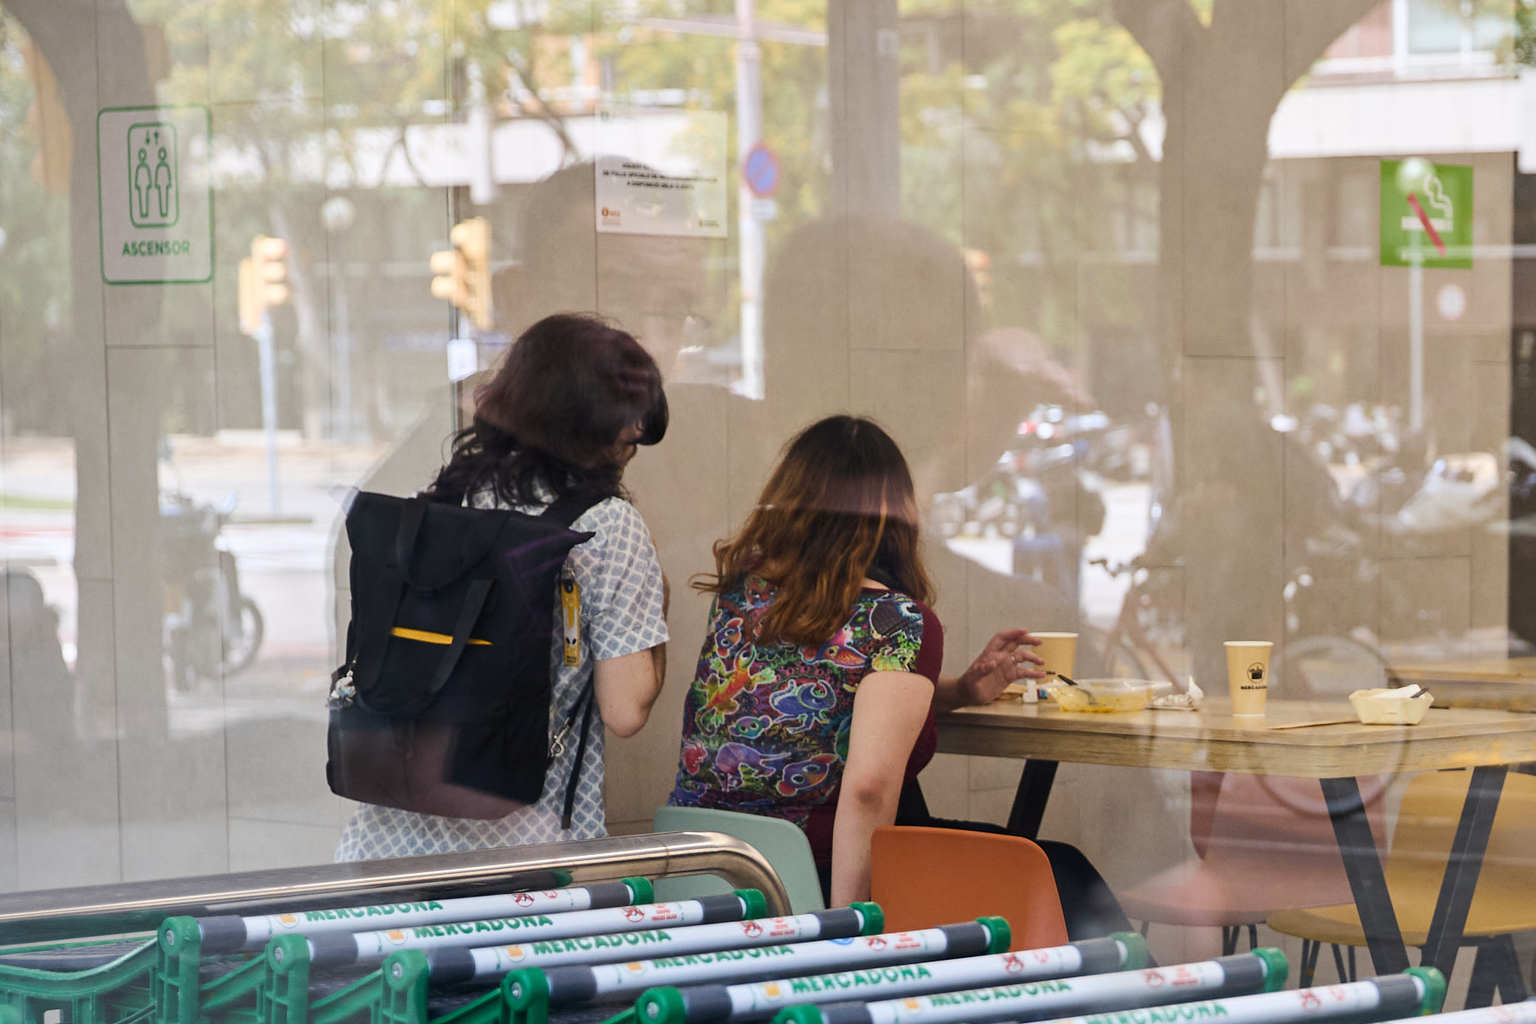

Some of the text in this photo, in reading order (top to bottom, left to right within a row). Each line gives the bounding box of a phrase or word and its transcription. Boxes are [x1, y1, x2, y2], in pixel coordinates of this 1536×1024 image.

[122, 240, 190, 256] ASCENSOR
[304, 900, 443, 922] MERCADONA
[413, 914, 553, 938] MERCADONA
[531, 929, 672, 956] MERCADONA
[652, 944, 795, 969] MERCADONA
[788, 964, 932, 995] MERCADONA
